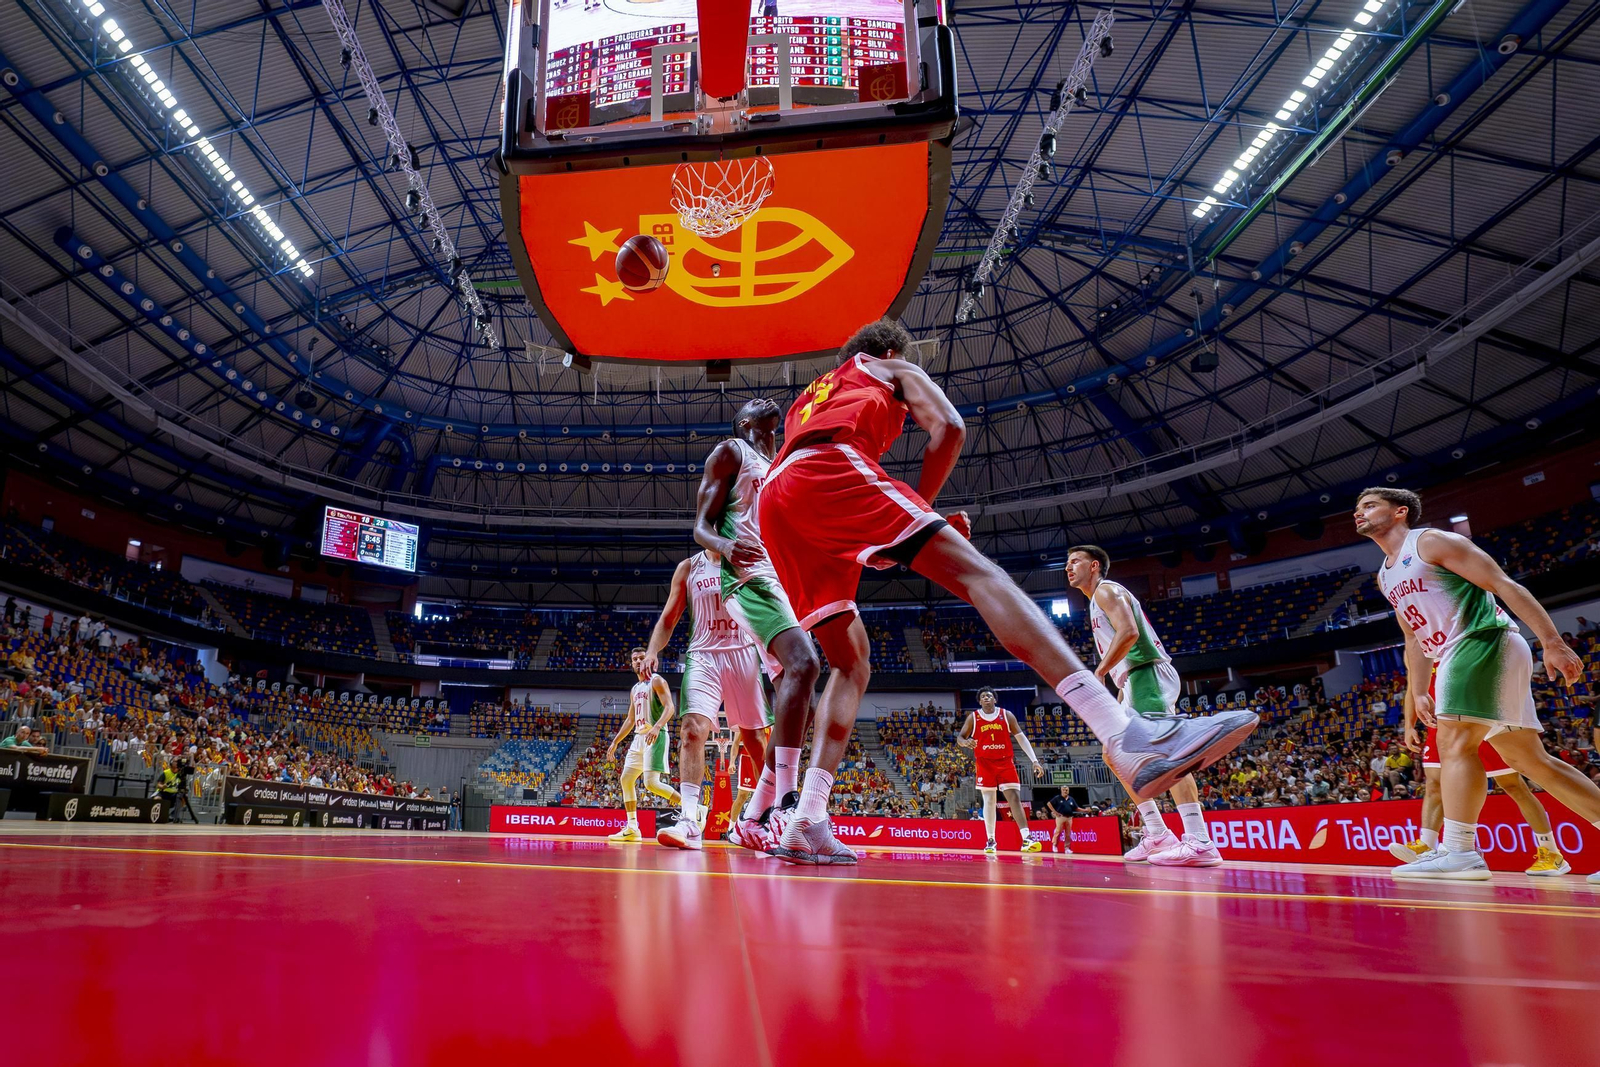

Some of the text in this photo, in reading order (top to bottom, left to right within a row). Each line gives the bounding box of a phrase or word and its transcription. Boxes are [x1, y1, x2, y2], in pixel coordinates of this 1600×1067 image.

[867, 20, 896, 30] GAMEIRO
[615, 29, 653, 42] FOLGUEIRAS
[868, 40, 887, 48] SILVA
[615, 51, 637, 62] MILLER
[870, 50, 888, 58] NUNO
[365, 535, 380, 544] 8:45
[696, 577, 721, 591] PORT
[1388, 578, 1428, 608] ORTUGAL
[981, 722, 1002, 732] ESPAÑA
[254, 788, 278, 799] endesa
[90, 805, 140, 818] #LaFamilia
[506, 814, 555, 825] IBERIA
[572, 816, 605, 827] Talento
[832, 826, 866, 836] ERIA
[889, 827, 929, 839] Talento
[940, 828, 972, 840] bordo
[1336, 817, 1420, 850] Talent
